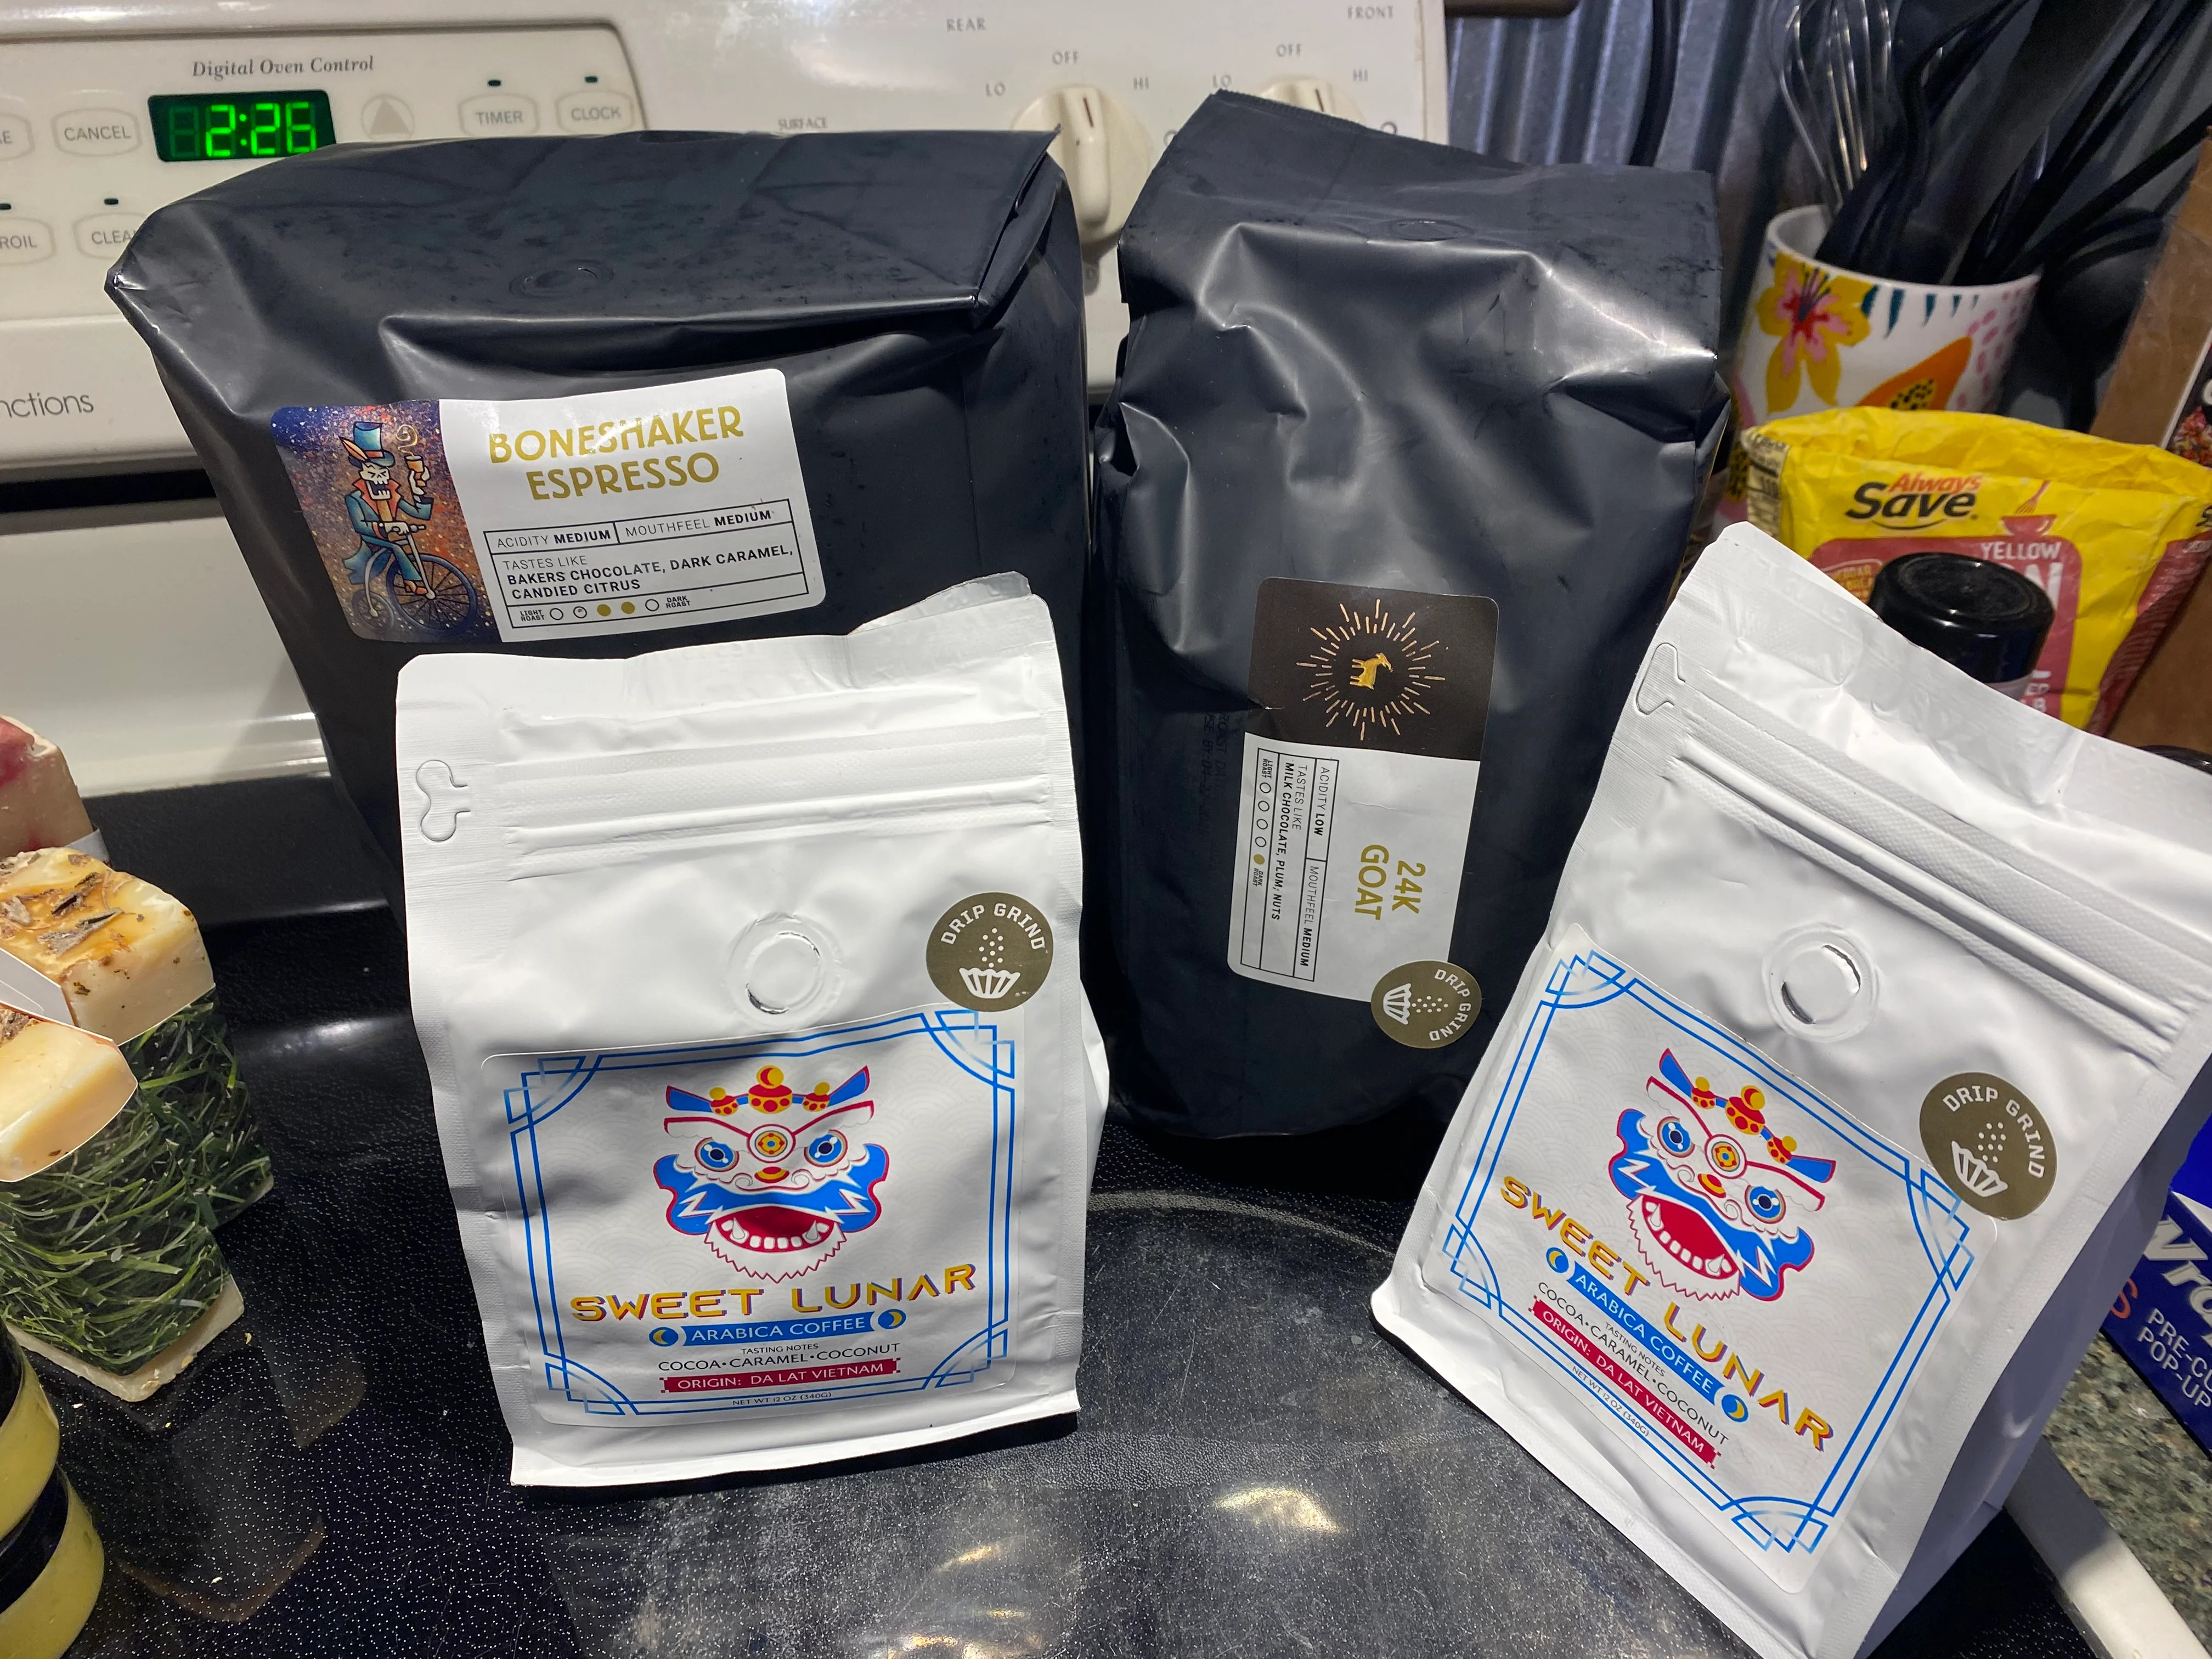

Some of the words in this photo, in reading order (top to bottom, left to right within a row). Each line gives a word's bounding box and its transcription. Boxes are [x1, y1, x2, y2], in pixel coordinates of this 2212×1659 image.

[946, 18, 986, 32] REAR
[1347, 5, 1394, 19] FRONT
[1052, 51, 1079, 65] OFF
[1276, 43, 1302, 57] OFF
[193, 59, 254, 81] Digital
[260, 59, 303, 75] Oven
[311, 55, 374, 73] Control
[1353, 69, 1368, 82] HI
[986, 82, 1006, 97] LO
[1133, 76, 1150, 90] HI
[1212, 75, 1232, 88] LO
[475, 110, 523, 125] TIMER
[571, 106, 621, 121] CLOCK
[64, 126, 132, 141] CANCEL
[206, 101, 317, 157] 2:26
[91, 229, 138, 245] CLEA
[489, 406, 743, 463] BONESHAKER
[526, 452, 719, 500] ESPRESSO
[1888, 472, 1983, 495] Always
[625, 518, 710, 537] MOUTHFEEL
[714, 510, 772, 527] MEDIUM
[497, 534, 548, 548] ACIDITY
[554, 529, 611, 545] MEDIUM
[1980, 541, 2062, 561] YELLOW
[503, 558, 554, 571] TASTES
[558, 555, 588, 567] LIKE
[507, 571, 566, 585] BAKERS
[570, 562, 666, 580] CHOCOLATE,
[670, 556, 712, 571] DARK
[716, 545, 793, 564] CARAMEL,
[511, 585, 578, 600] CANDIED
[584, 579, 641, 595] CITRUS
[1283, 762, 1295, 789] MILK
[1295, 765, 1307, 804] TASTES
[1317, 766, 1330, 810] ACIDITY
[1276, 792, 1291, 856] CHOCOLATE,
[1292, 808, 1303, 830] LIKE
[1314, 813, 1325, 836] LOW
[1272, 860, 1285, 890] PLUM,
[1355, 844, 1389, 920] GOAT
[1392, 860, 1426, 914] 24K
[1272, 894, 1282, 920] NUTS
[1305, 866, 1319, 924] MOUTHFEEL
[940, 905, 985, 945] DRIP
[994, 903, 1046, 950] GRIND
[1300, 928, 1312, 966] MEDIUM
[1434, 969, 1471, 997] DRIP
[1429, 1003, 1471, 1041] GRIND
[1943, 1085, 1998, 1112] DRIP
[2006, 1099, 2045, 1178] GRIND
[570, 1289, 764, 1321] SWEET
[792, 1263, 976, 1313] LUNAR
[1500, 1176, 1650, 1296] SWEET
[1664, 1301, 1834, 1452] LUNAR
[691, 1324, 783, 1341] ARABICA
[789, 1317, 865, 1335] COFFEE
[1575, 1274, 1645, 1339] ARABICA
[1650, 1335, 1714, 1394] COFFEE
[742, 1346, 783, 1355] TASTING
[786, 1343, 819, 1352] NOTES
[1605, 1321, 1638, 1353] TASTING
[1638, 1351, 1666, 1377] NOTES
[678, 1377, 742, 1389] ORIGIN:
[751, 1374, 773, 1385] DA
[778, 1371, 806, 1383] LAT
[812, 1363, 883, 1379] VIETNAM
[2137, 1327, 2211, 1407] POP-UP
[1543, 1311, 1591, 1356] ORIGIN:
[1596, 1355, 1615, 1376] DA
[1618, 1373, 1643, 1397] LAT
[1646, 1395, 1704, 1453] VIETNAM
[800, 1392, 832, 1401] (340G)
[1572, 1366, 1588, 1382] NET
[1590, 1380, 1602, 1394] WT
[1603, 1392, 1611, 1402] 12
[1610, 1400, 1623, 1413] OZ
[1623, 1410, 1649, 1437] (340G)
